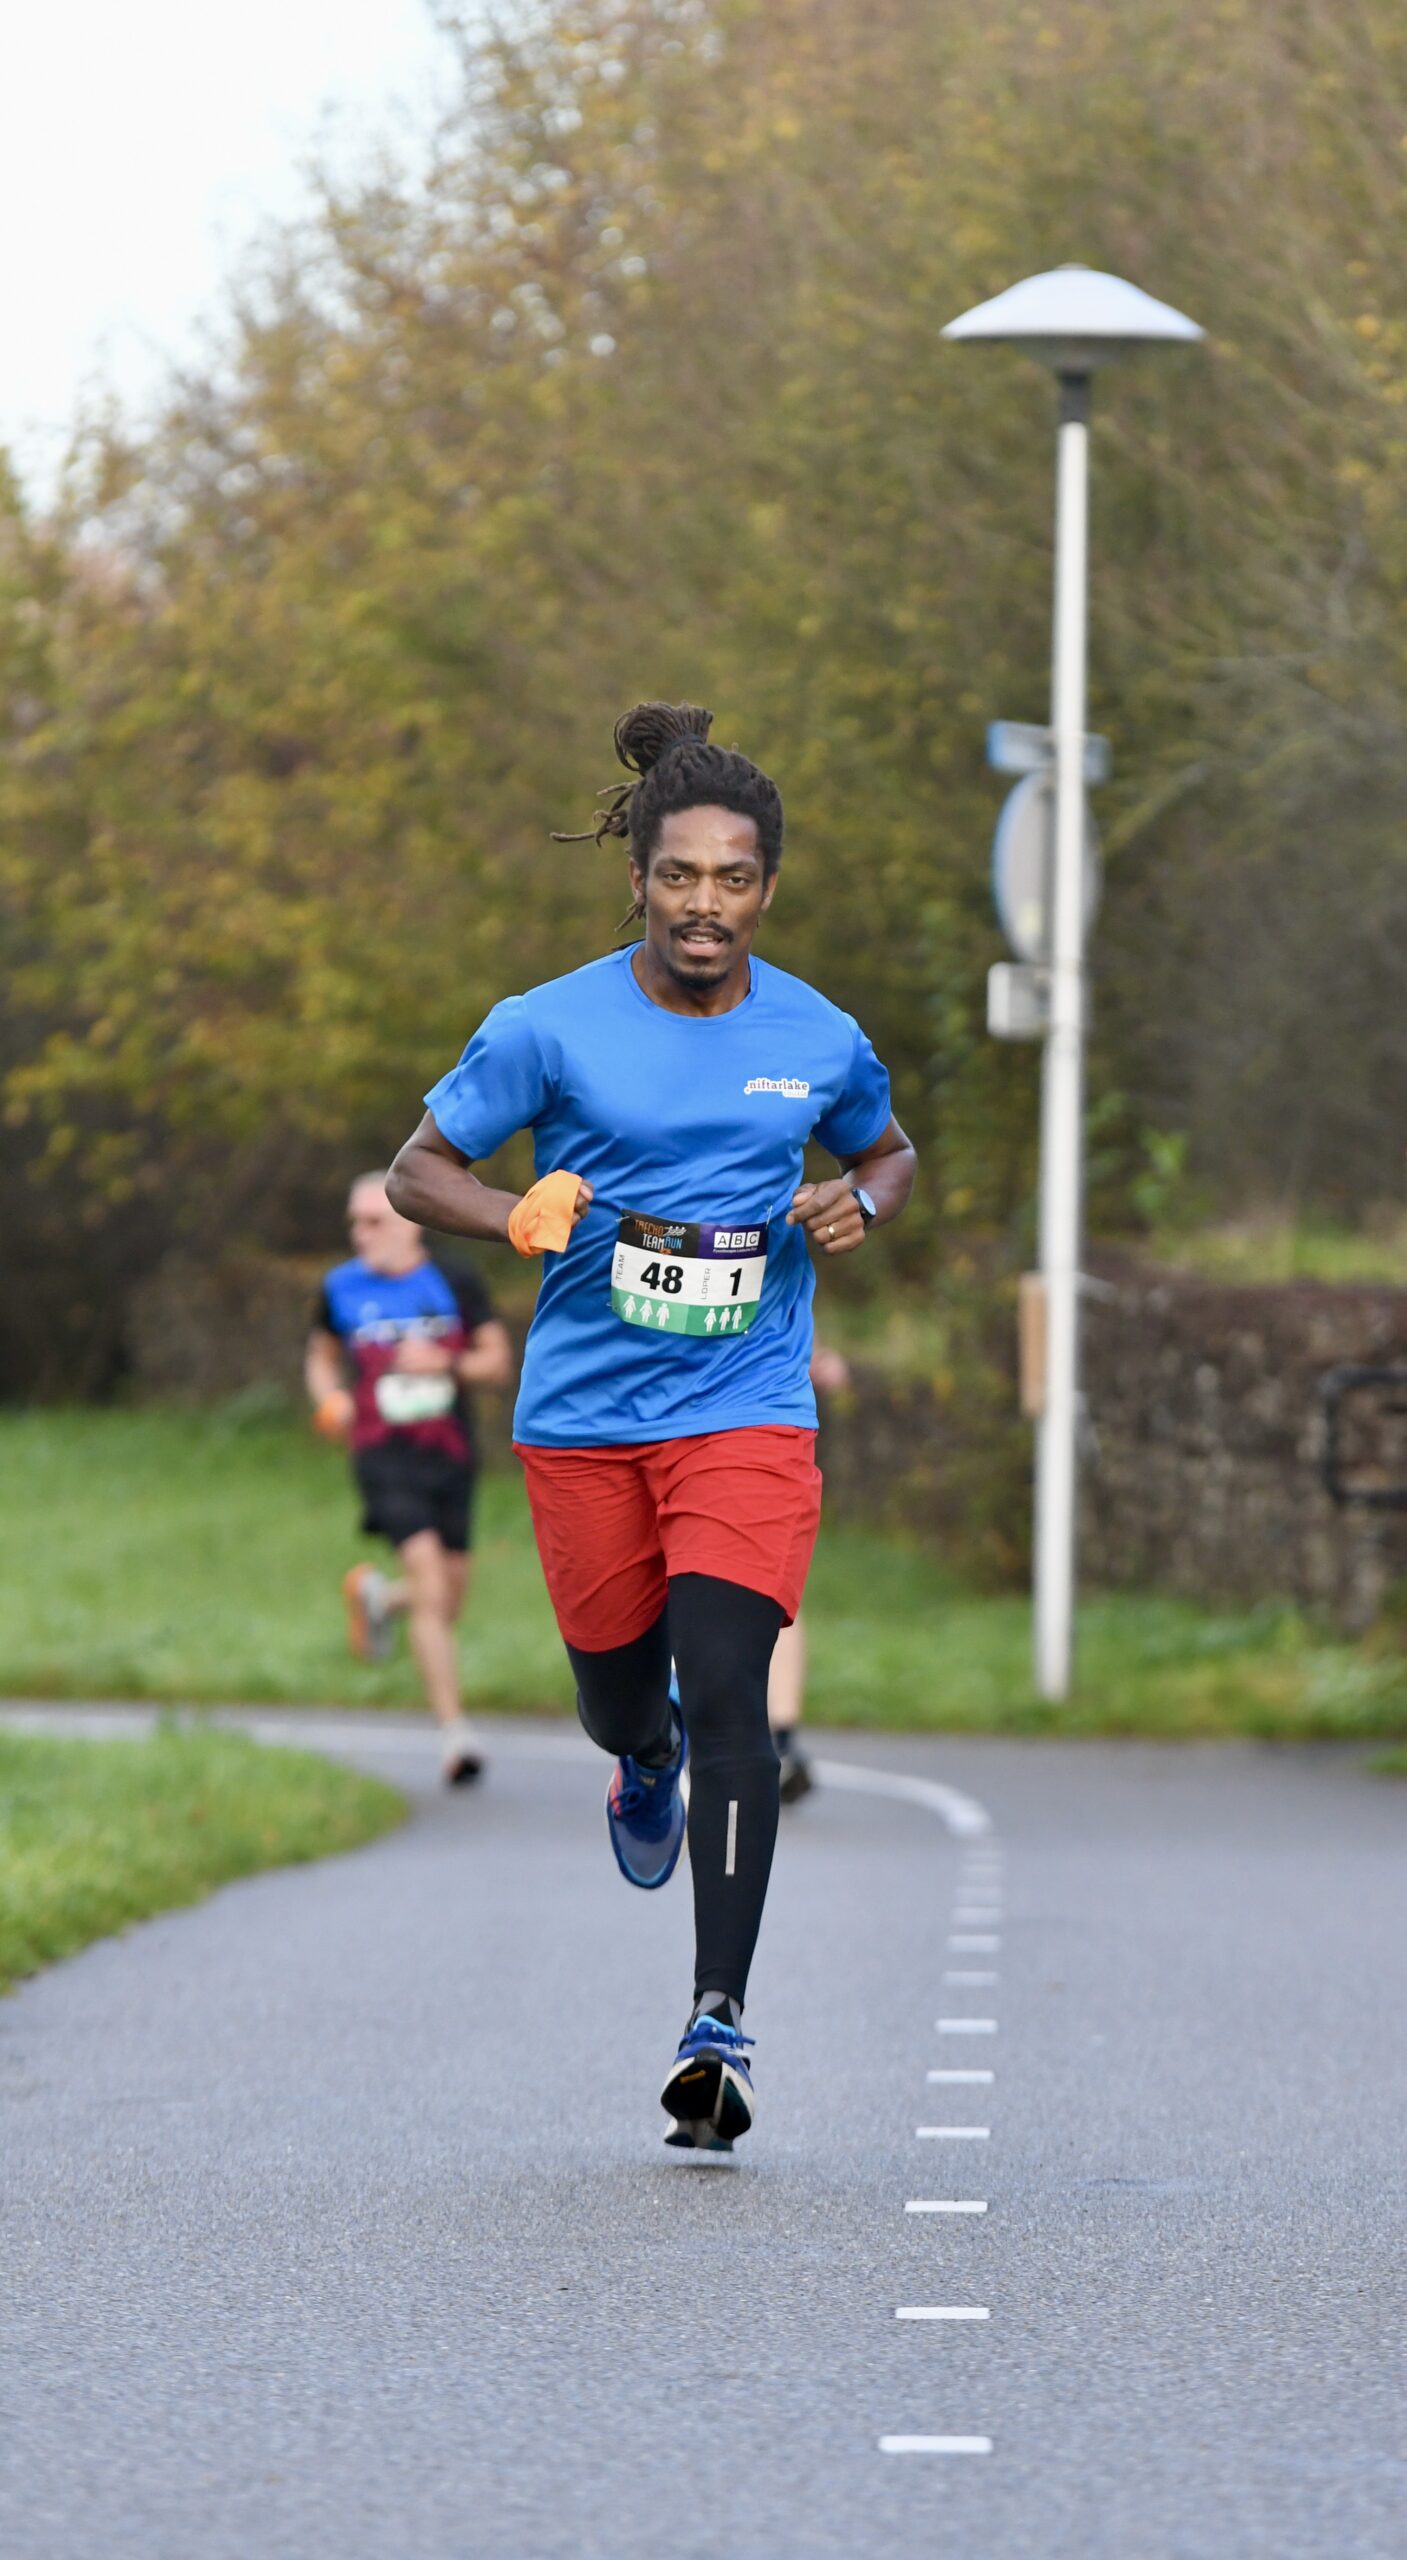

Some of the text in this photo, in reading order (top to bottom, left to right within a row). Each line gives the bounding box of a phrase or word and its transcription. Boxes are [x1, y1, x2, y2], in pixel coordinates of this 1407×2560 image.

[615, 1254, 625, 1280] TEAM
[640, 1261, 684, 1294] 48
[729, 1267, 742, 1296] 1
[701, 1267, 711, 1300] LOPER
